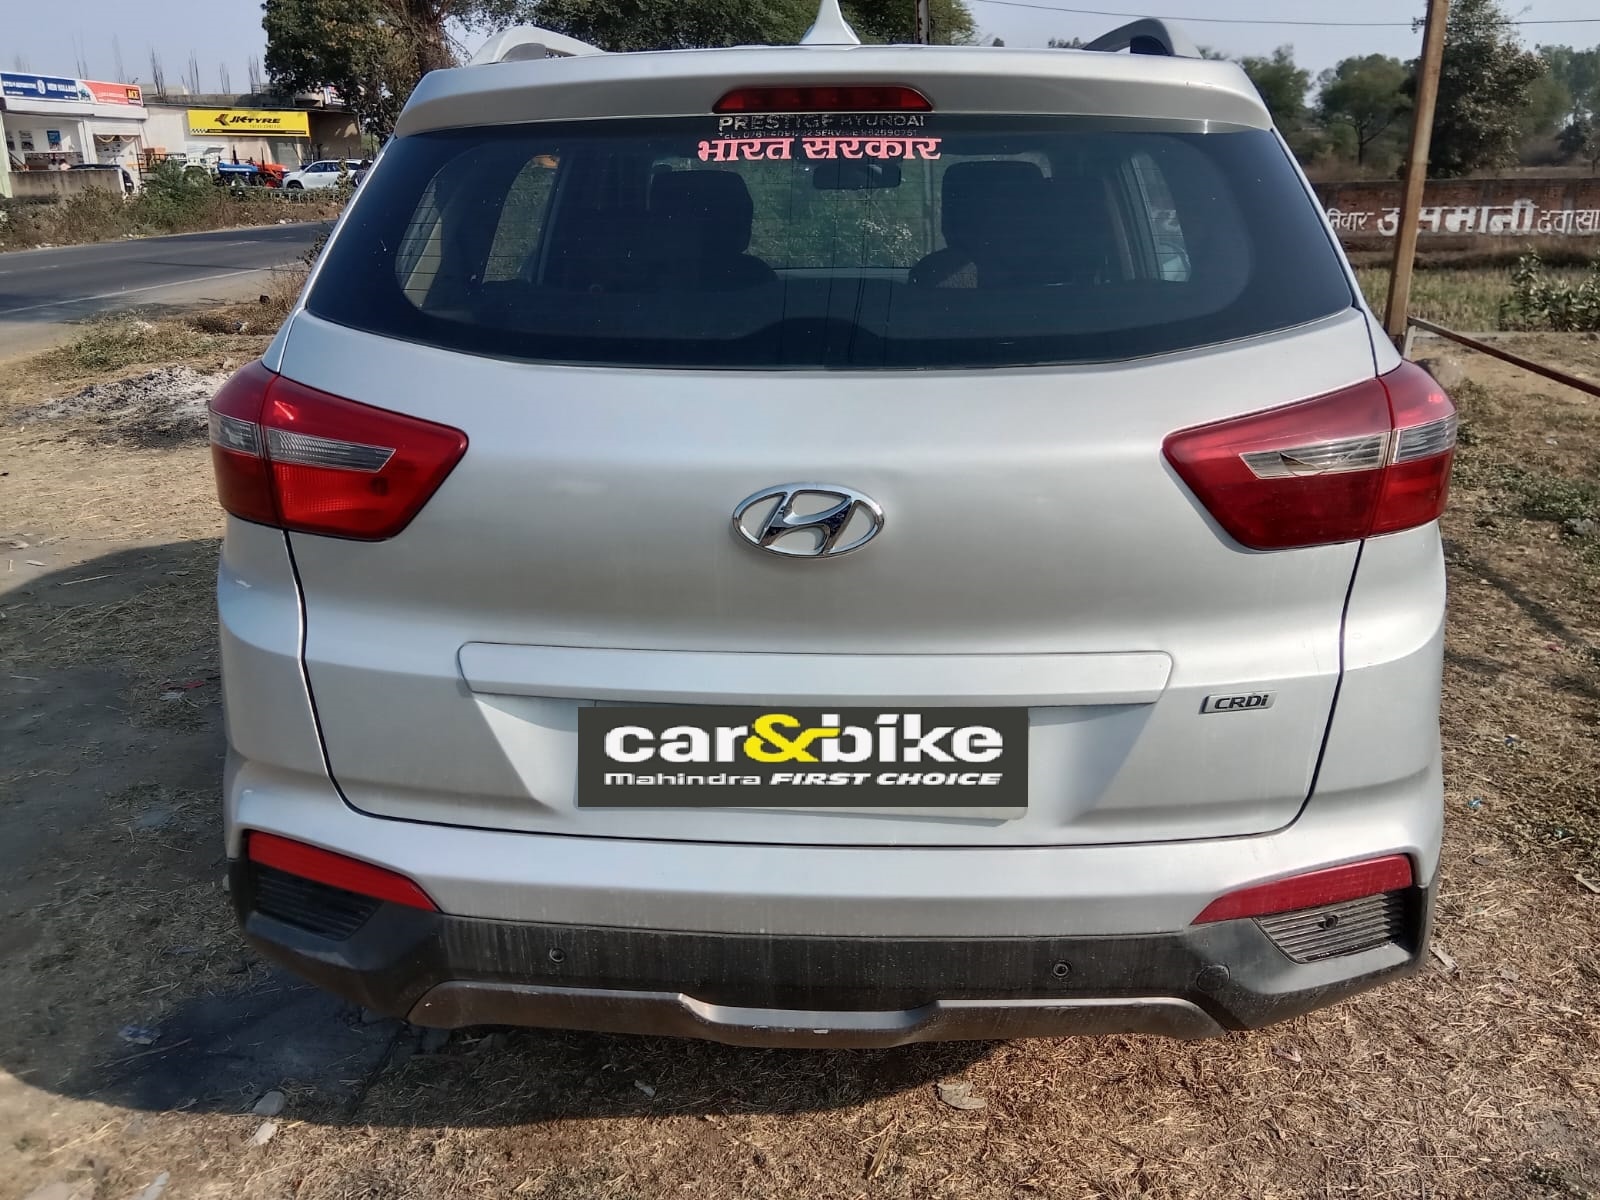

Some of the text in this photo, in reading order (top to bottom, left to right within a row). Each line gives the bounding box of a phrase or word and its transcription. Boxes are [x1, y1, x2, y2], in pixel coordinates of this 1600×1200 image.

[718, 114, 833, 131] PRESTIGE
[698, 137, 942, 162] भारत सरकार
[1214, 694, 1269, 710] CRDi
